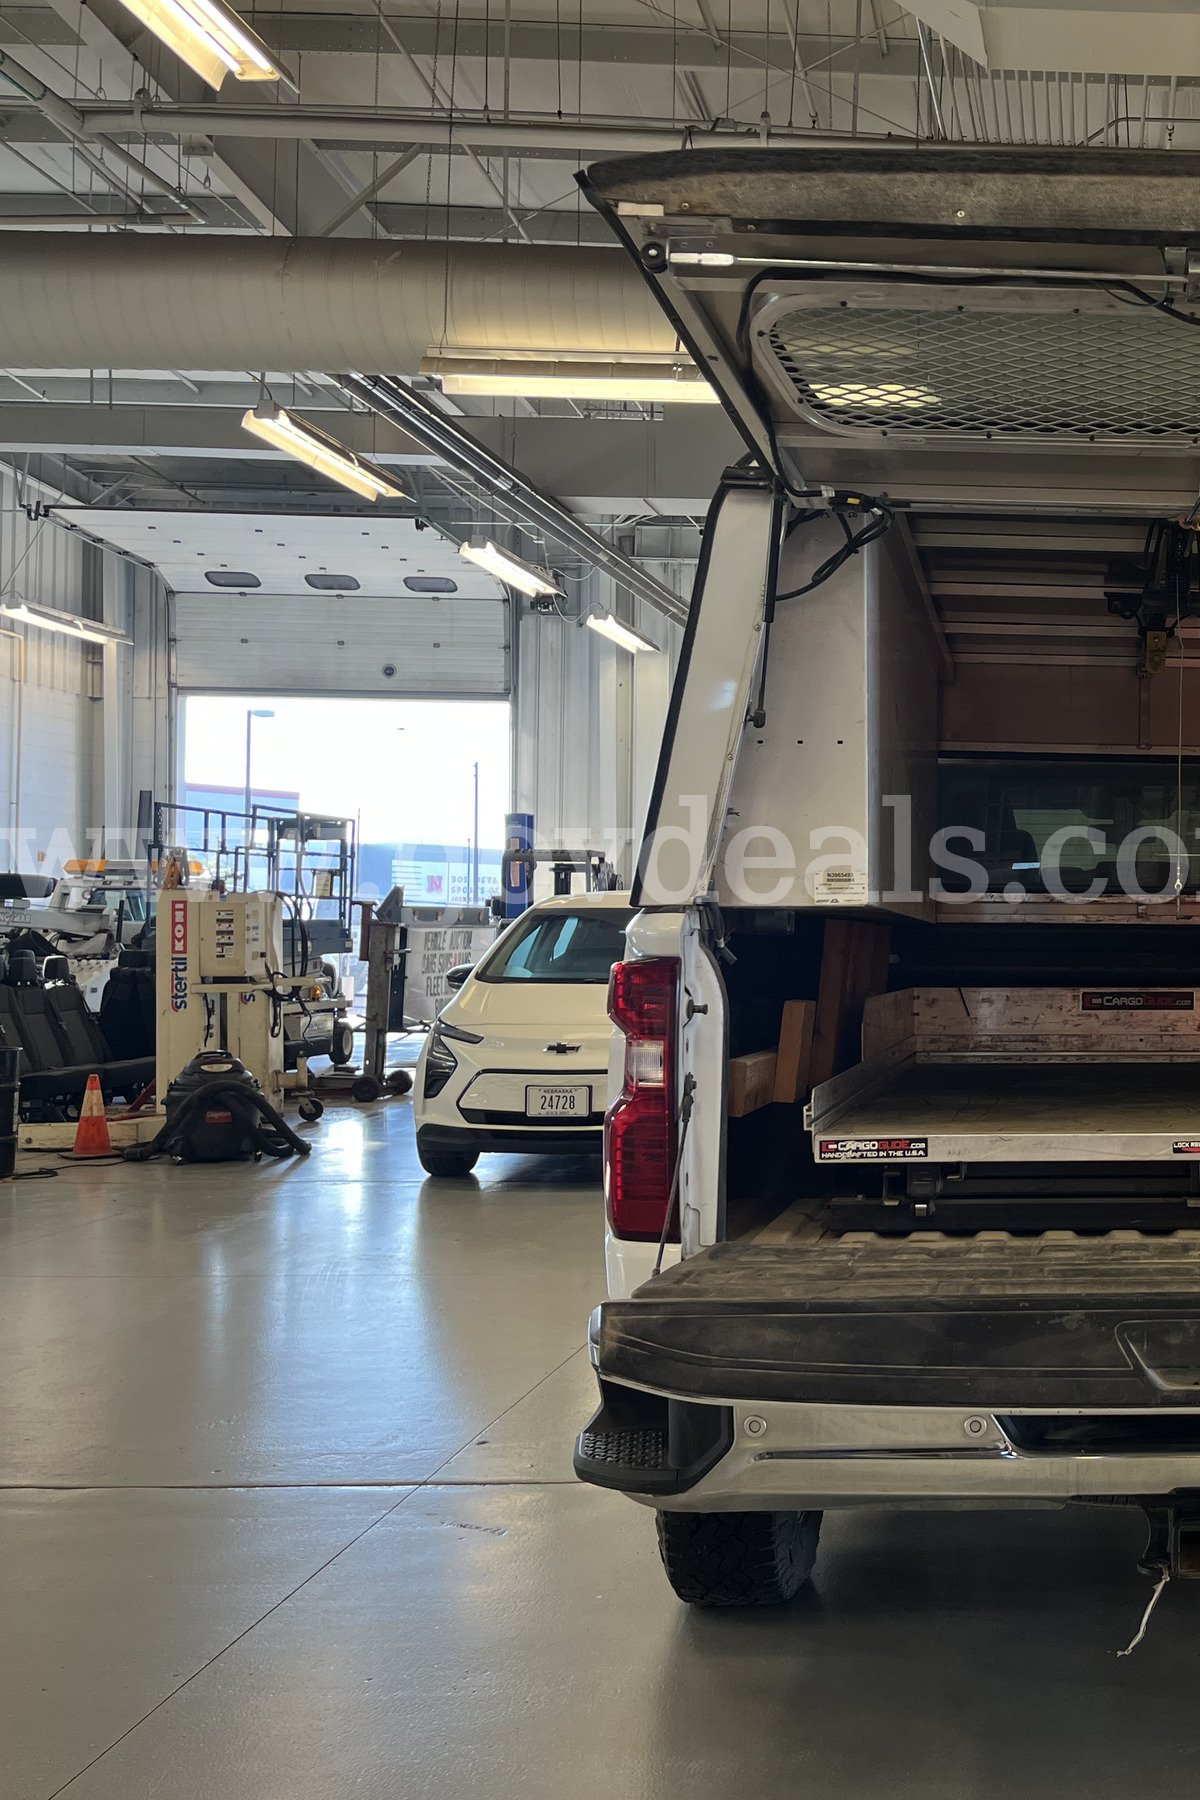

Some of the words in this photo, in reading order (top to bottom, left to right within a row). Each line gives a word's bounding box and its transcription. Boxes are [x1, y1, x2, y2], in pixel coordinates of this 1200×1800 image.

[174, 903, 184, 952] KONI
[171, 957, 188, 1012] stertil
[540, 1095, 576, 1110] 24728
